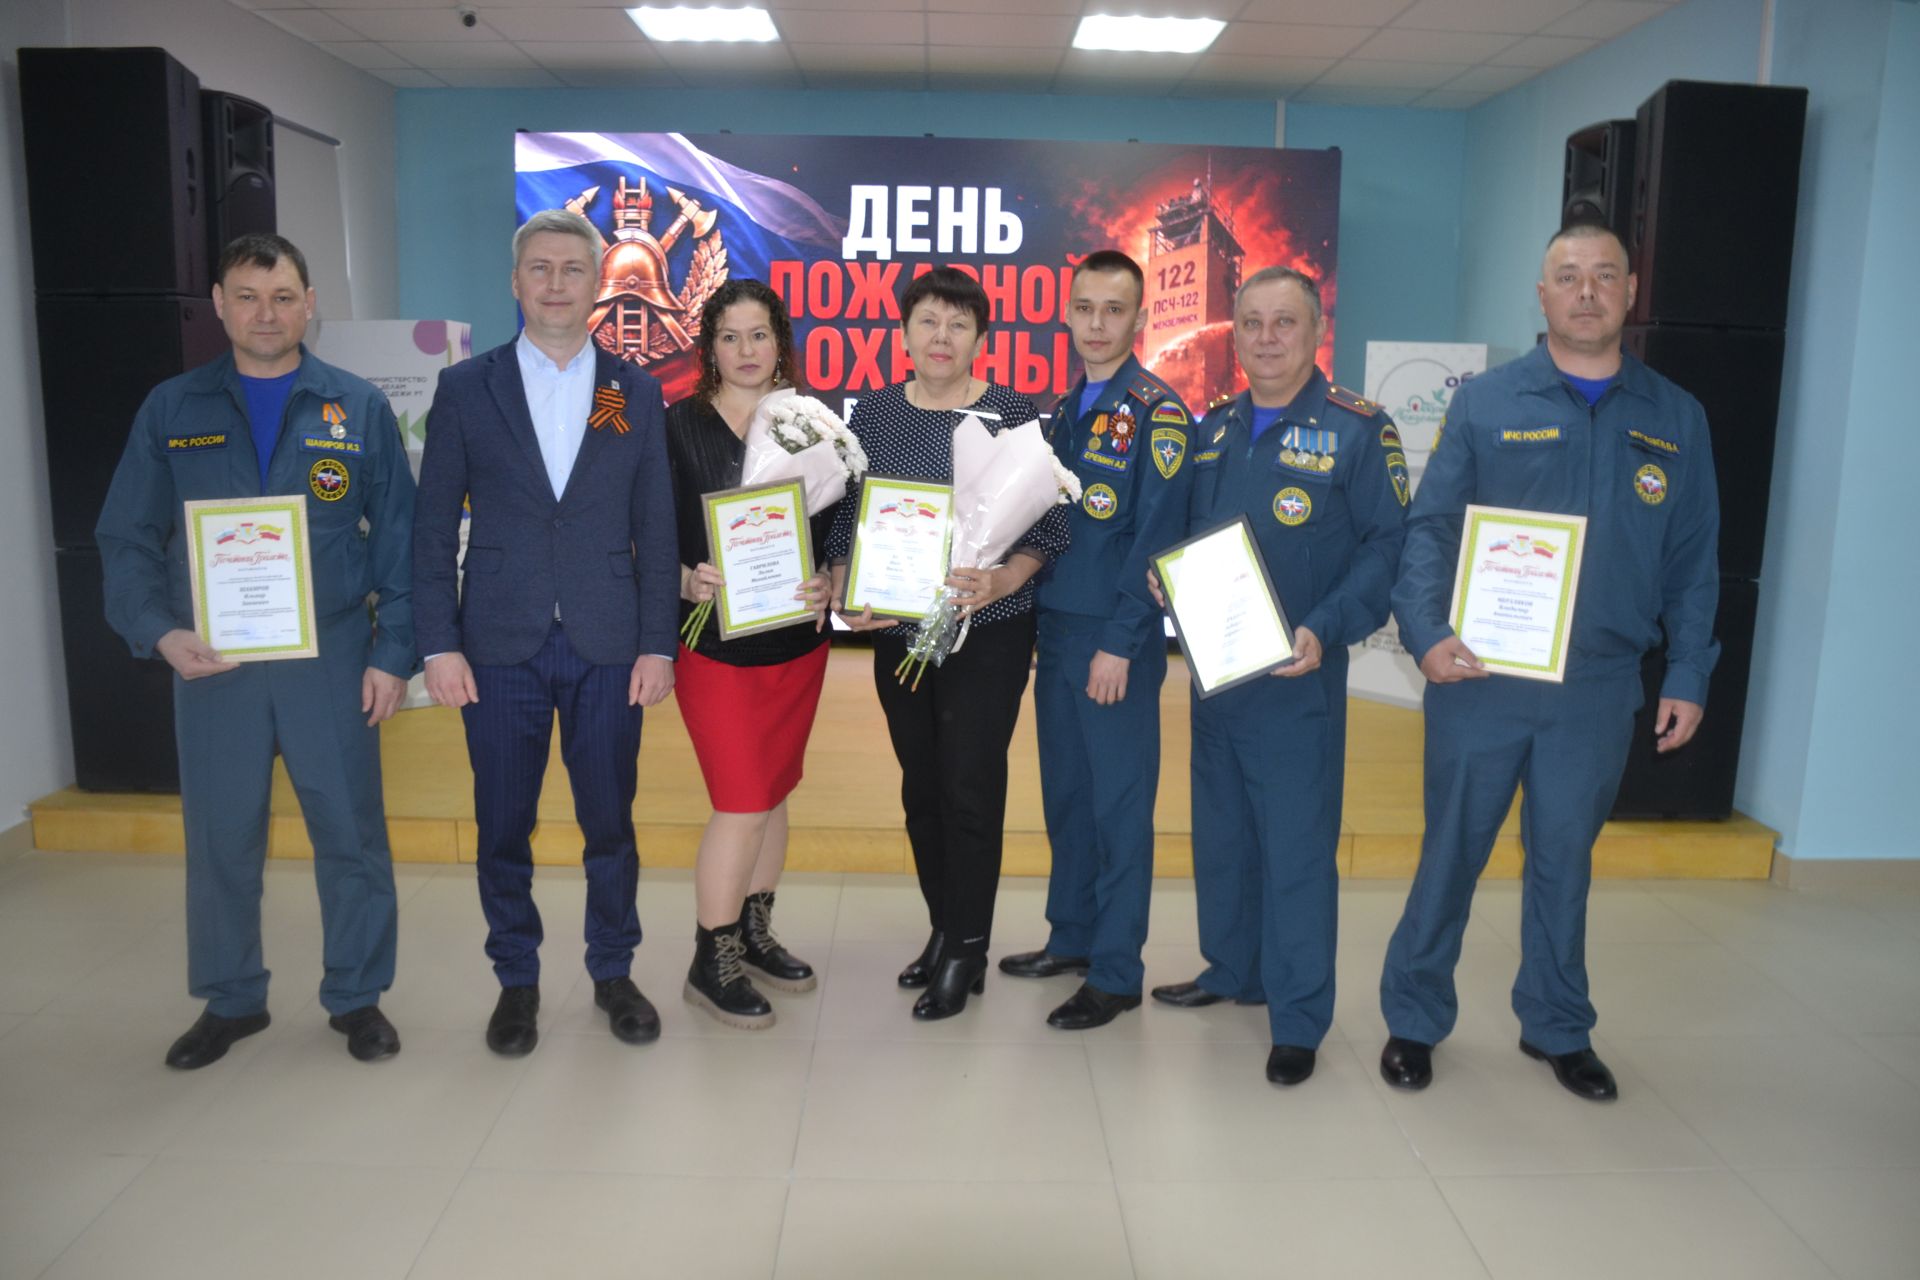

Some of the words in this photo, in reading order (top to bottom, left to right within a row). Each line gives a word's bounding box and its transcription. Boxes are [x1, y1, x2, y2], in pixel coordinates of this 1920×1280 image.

[842, 185, 1023, 260] ДЕНЬ
[770, 253, 1089, 324] ПОЖНО
[1158, 261, 1196, 291] 122
[1153, 291, 1199, 315] ПСЧ-122
[806, 326, 1069, 394] ОХРНЫ
[168, 438, 188, 449] МЧС
[189, 435, 225, 447] РОССИИ
[1503, 430, 1522, 441] МЧС
[1523, 428, 1560, 440] РОССИИ
